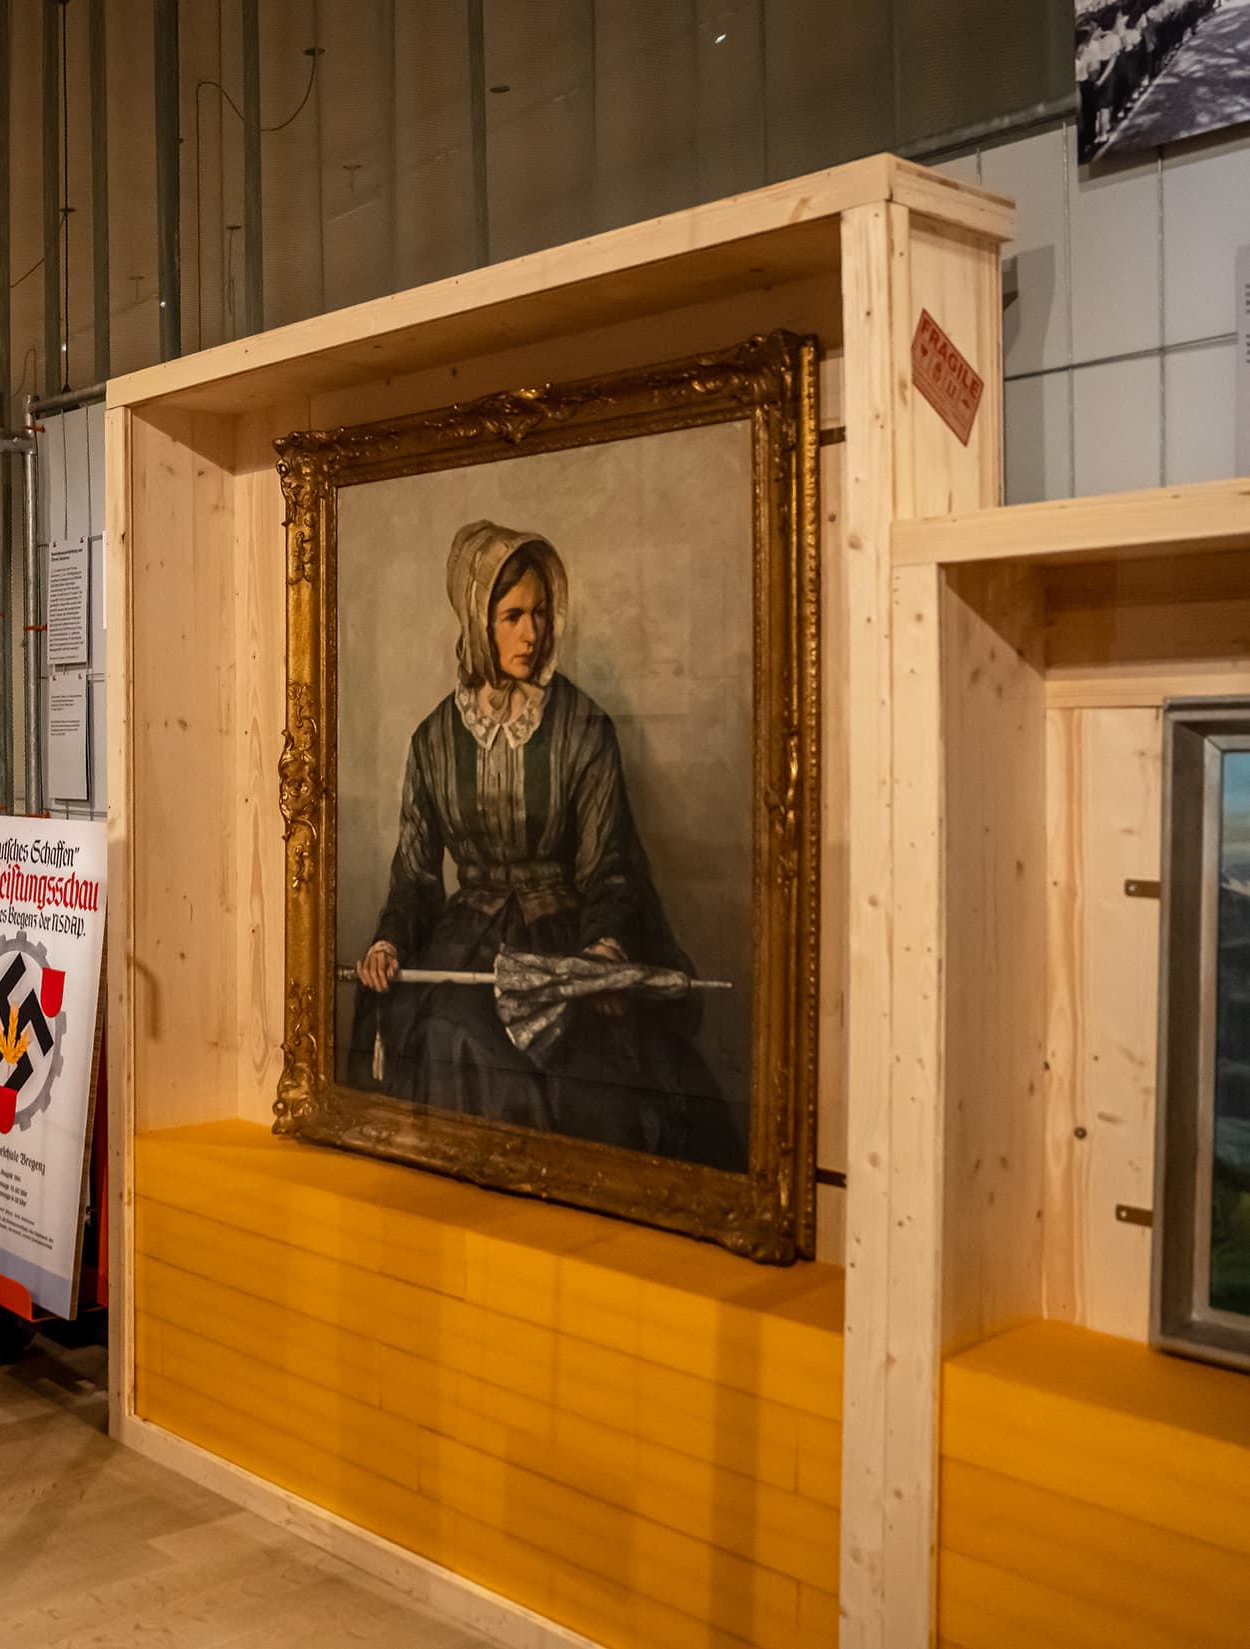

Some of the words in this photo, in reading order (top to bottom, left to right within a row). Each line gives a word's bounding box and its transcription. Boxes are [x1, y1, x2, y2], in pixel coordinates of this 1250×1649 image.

[921, 317, 980, 400] FRAGILE
[8, 906, 38, 931] Bregenz
[38, 911, 51, 933] der
[20, 1152, 46, 1176] Bregenz
